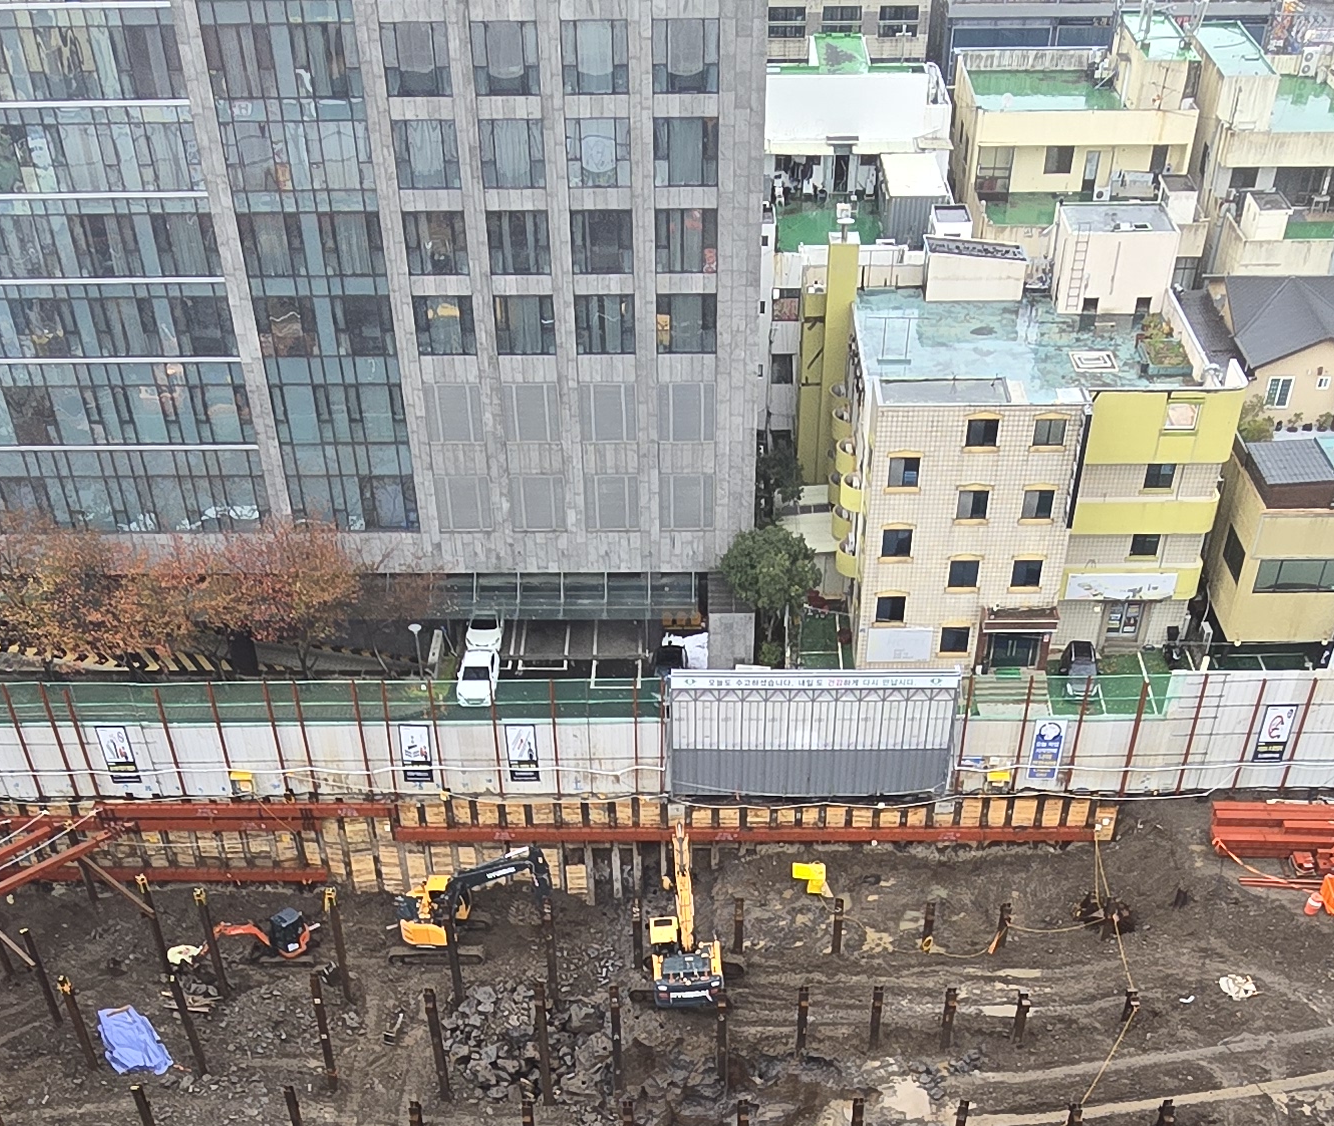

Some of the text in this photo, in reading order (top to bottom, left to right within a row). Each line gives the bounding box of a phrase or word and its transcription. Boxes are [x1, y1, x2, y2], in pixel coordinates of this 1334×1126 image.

[708, 679, 731, 687] 오늘도
[736, 679, 794, 687] 수고하셨습니다.
[798, 679, 814, 687] 내일
[828, 679, 859, 687] 건강하게
